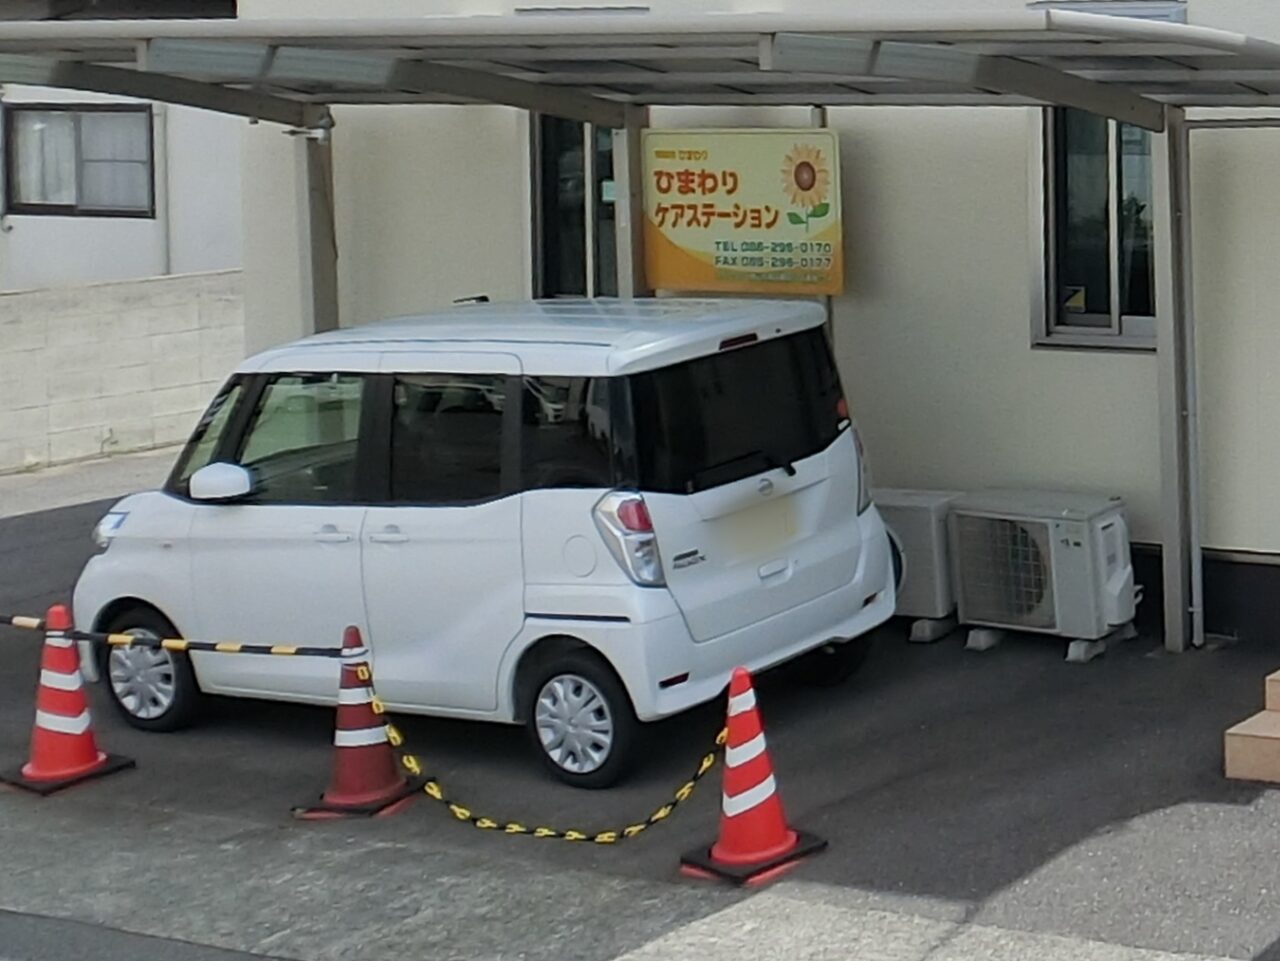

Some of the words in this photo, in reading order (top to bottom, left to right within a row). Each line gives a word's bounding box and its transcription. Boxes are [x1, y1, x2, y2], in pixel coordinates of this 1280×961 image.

[653, 169, 739, 196] ひまわり
[655, 203, 779, 229] ケアステーション
[715, 241, 738, 252] TEL
[714, 256, 738, 266] FAX
